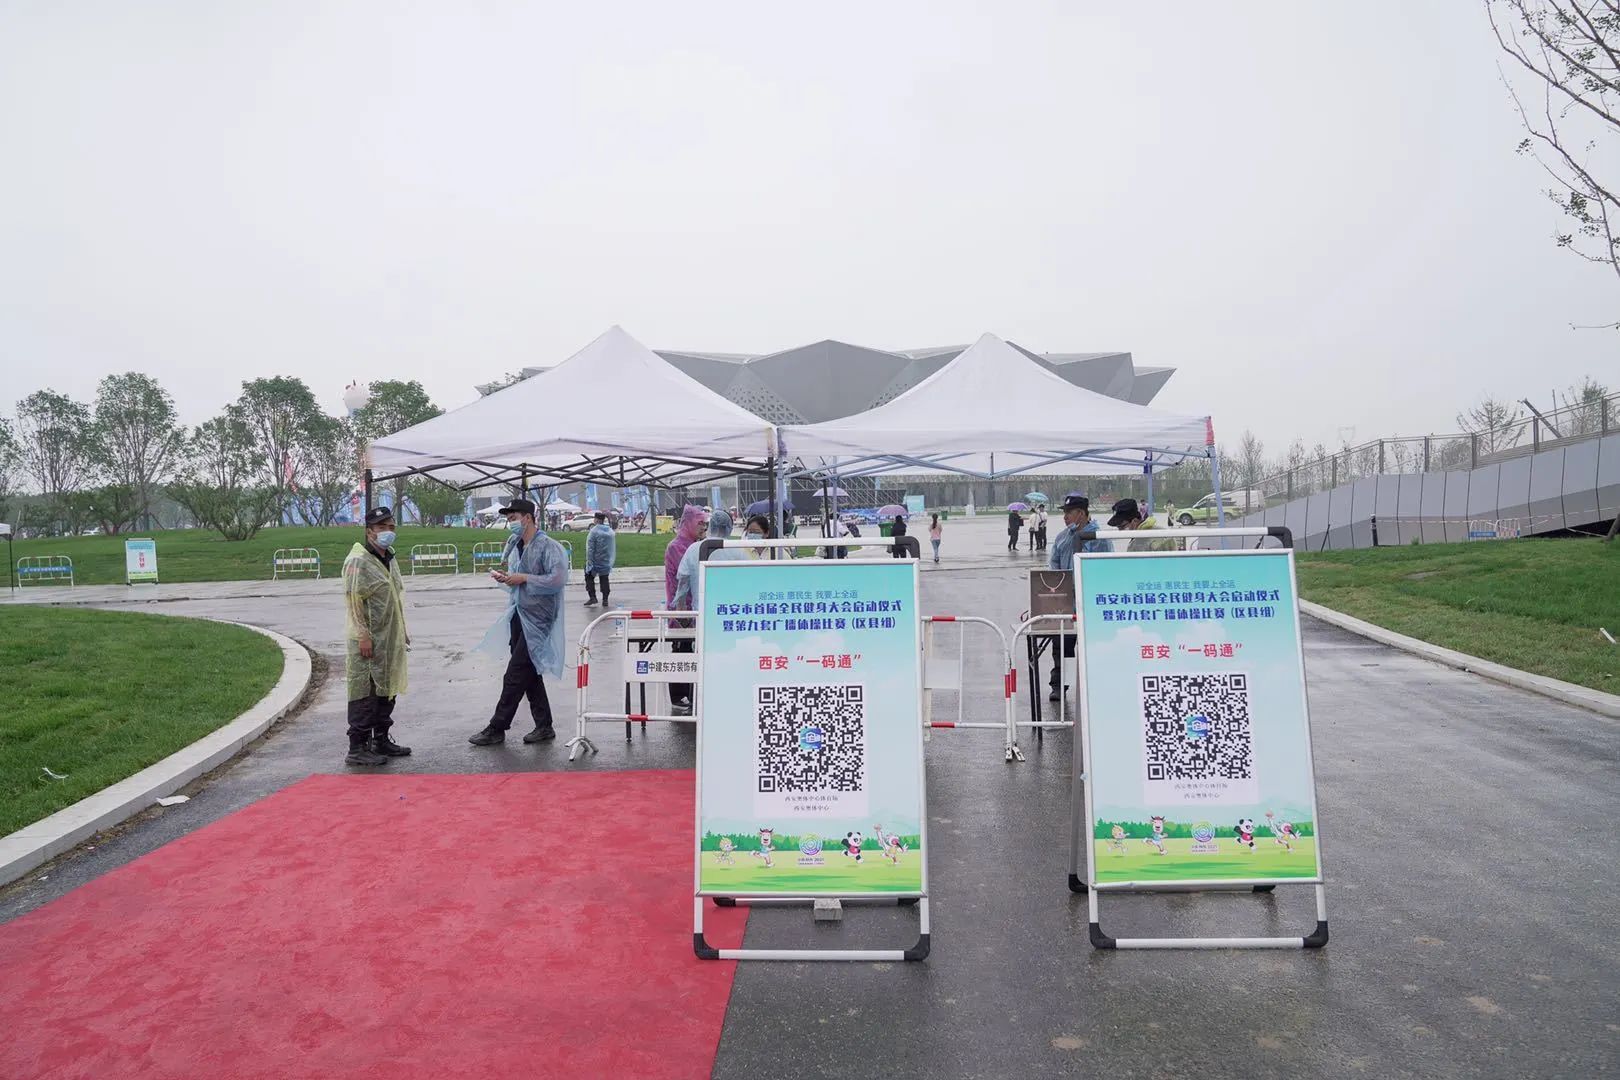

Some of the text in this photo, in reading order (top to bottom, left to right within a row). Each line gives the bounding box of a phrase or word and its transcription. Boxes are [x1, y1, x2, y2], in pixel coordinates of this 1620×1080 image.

[758, 589, 858, 600] 迎全运 惠民生 我要上全运
[1096, 590, 1280, 605] 西安市首届全民健身大会启动仪式
[717, 600, 902, 616] 西安市首届全民健身大会启动仪式
[648, 661, 698, 673] 中建东方装饰有
